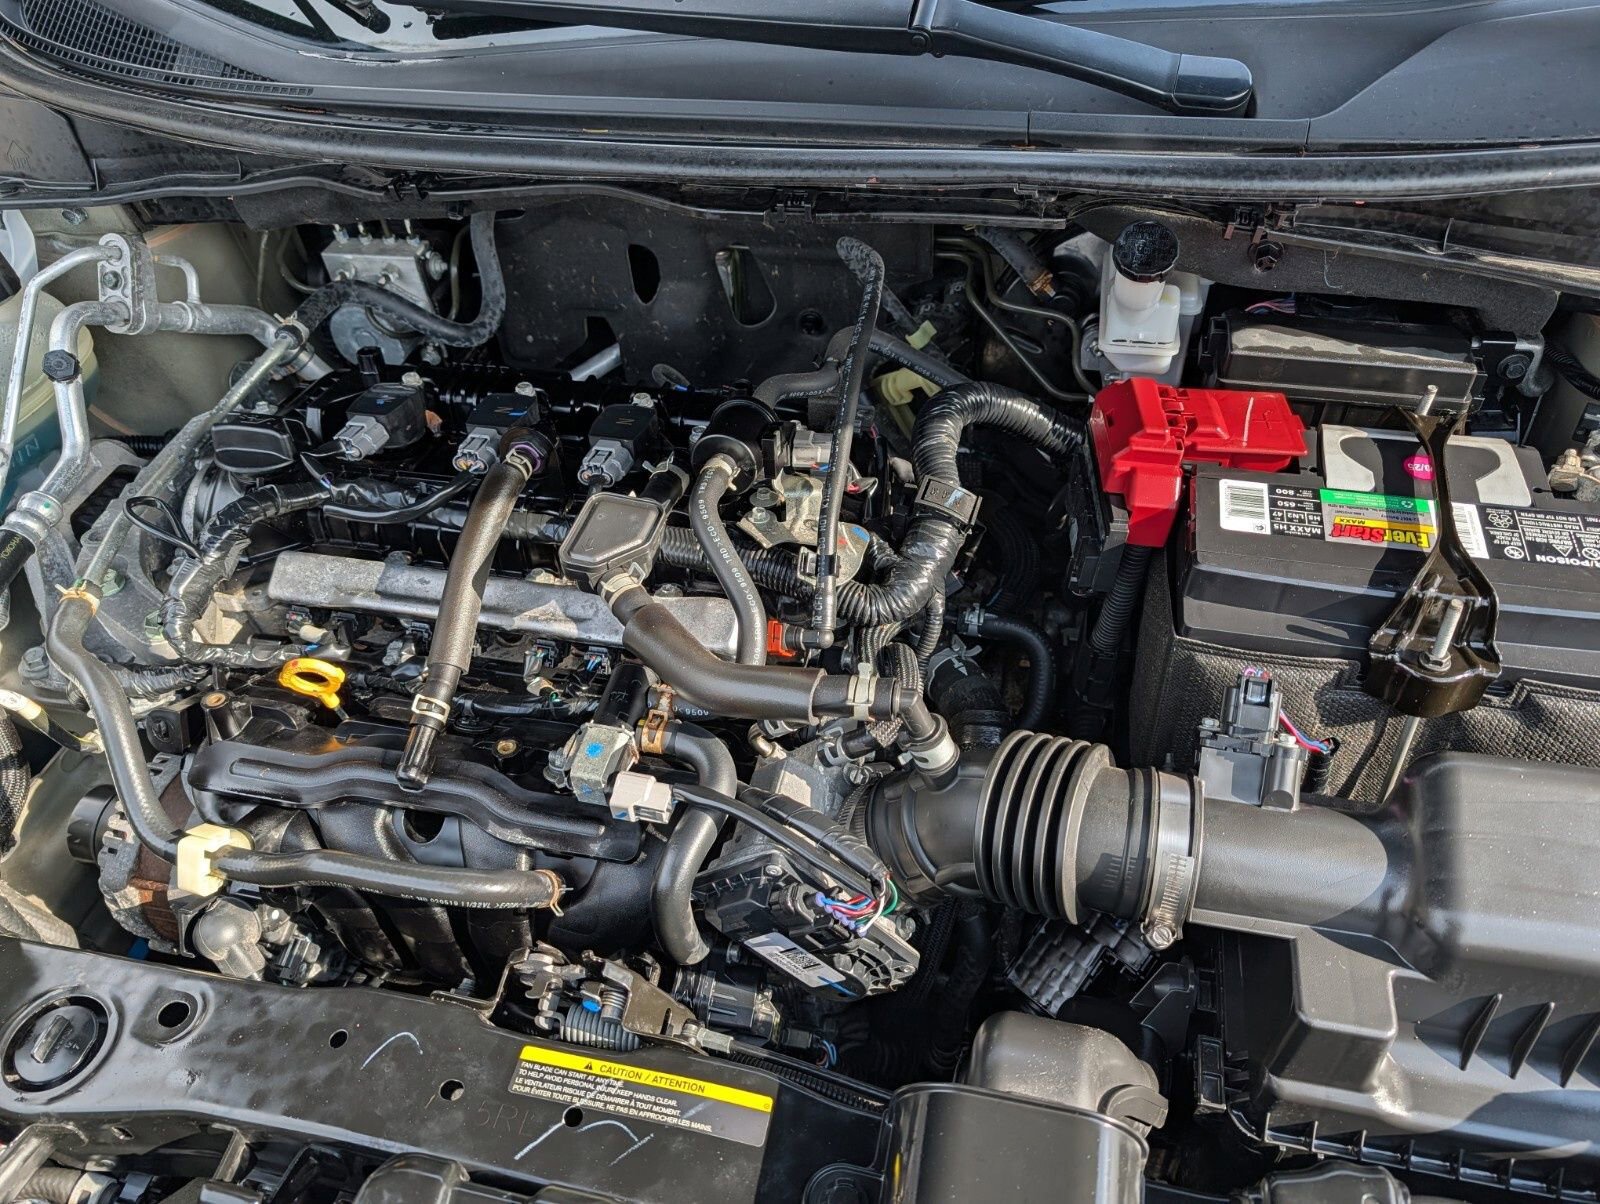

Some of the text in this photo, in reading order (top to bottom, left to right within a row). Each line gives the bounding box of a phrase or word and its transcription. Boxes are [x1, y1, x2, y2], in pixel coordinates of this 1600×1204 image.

[1277, 499, 1295, 507] 650
[1289, 524, 1321, 534] MAXX
[1331, 521, 1431, 549] EverStart
[521, 1061, 534, 1070] FAN
[533, 1063, 553, 1073] BLADE
[554, 1067, 567, 1076] CAN
[568, 1069, 587, 1079] START
[587, 1073, 596, 1081] AT
[600, 1064, 642, 1080] CAUTION
[652, 1075, 706, 1093] ATTENTION
[524, 1078, 562, 1092] VENTILATEUR
[562, 1086, 586, 1097] RISQUE
[595, 1091, 630, 1105] DÉMARRER
[635, 1102, 652, 1110] TOUT
[528, 1070, 544, 1079] HELP
[544, 1074, 562, 1083] AVOID
[563, 1077, 595, 1091] PERSONAL
[616, 1088, 633, 1097] KEEP
[633, 1092, 655, 1102] HANDS
[512, 1084, 531, 1093] POUR
[530, 1086, 552, 1098] ÉVITER
[552, 1092, 572, 1102] TOUTE
[606, 1103, 615, 1111] NE
[615, 1105, 628, 1114] PAS
[628, 1108, 638, 1116] EN
[638, 1110, 678, 1124] APPROCHER
[678, 1118, 690, 1127] LES
